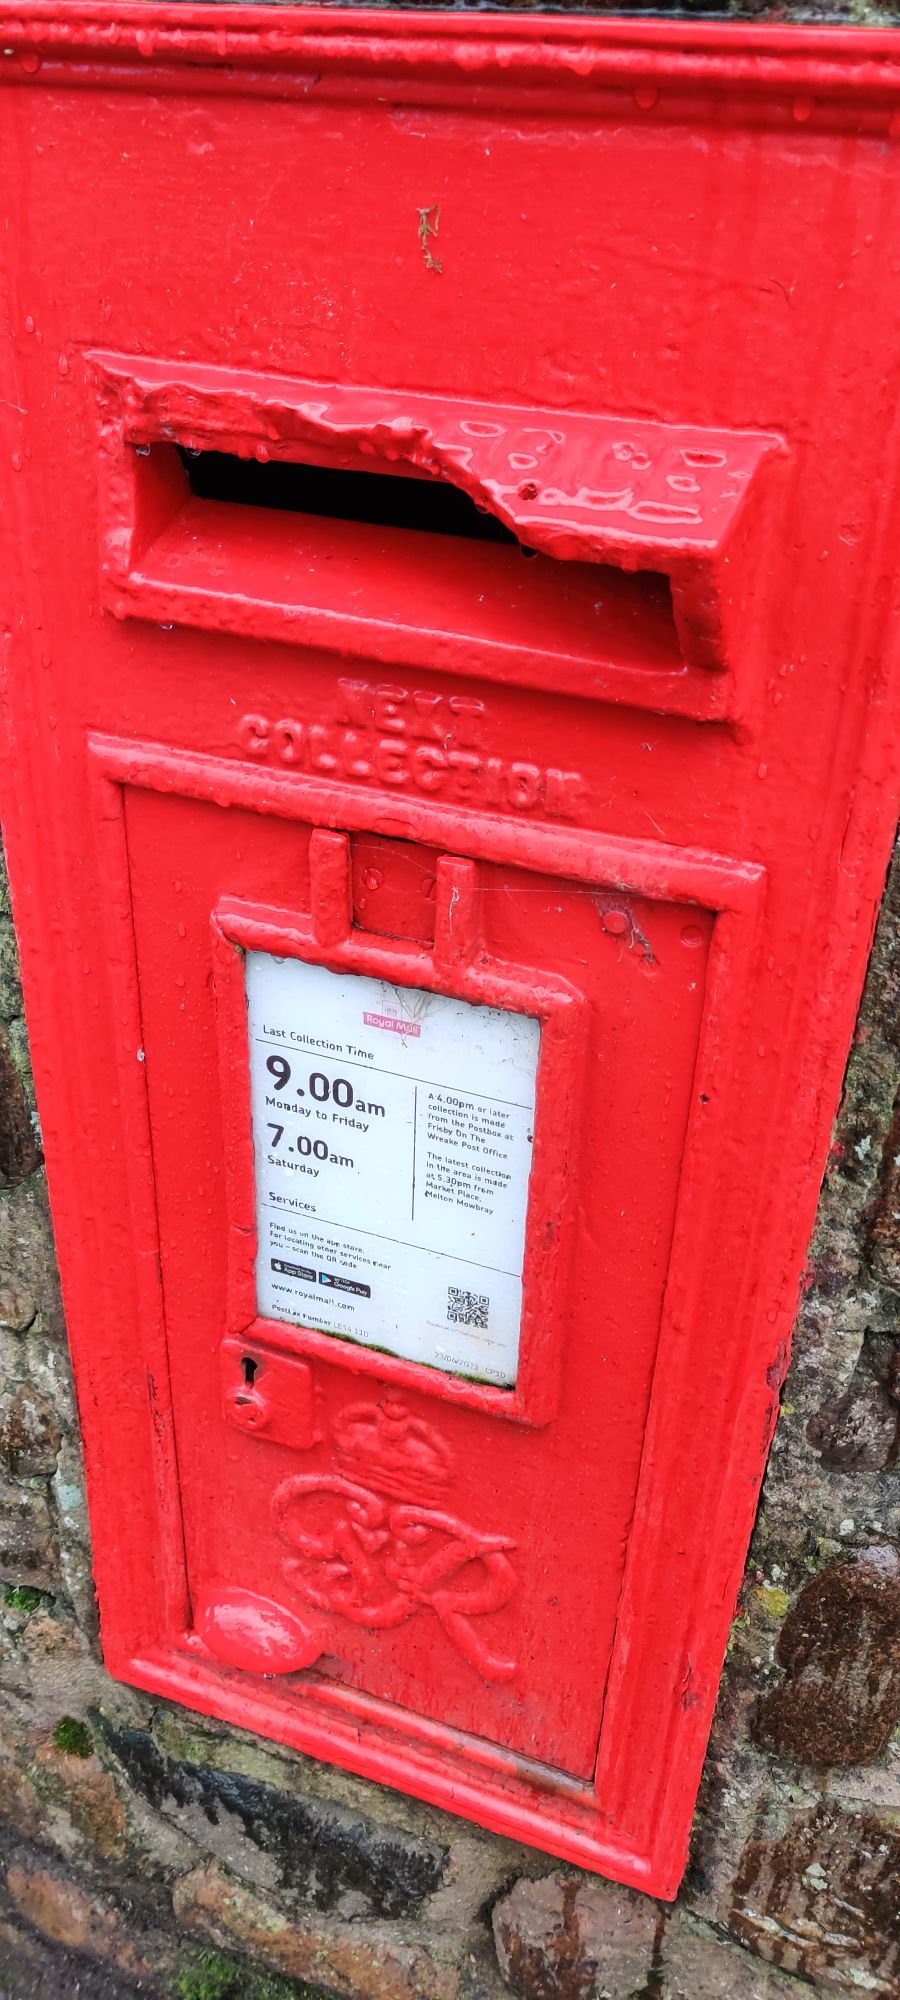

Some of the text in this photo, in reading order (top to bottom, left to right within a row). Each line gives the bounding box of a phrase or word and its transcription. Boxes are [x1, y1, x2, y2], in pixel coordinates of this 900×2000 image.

[238, 712, 585, 818] COLLECTION
[366, 1014, 394, 1029] Royal
[263, 1024, 375, 1060] Last Collection Time
[266, 1055, 386, 1118] 9.00am
[265, 1096, 370, 1133] Monday to Friday
[428, 1092, 510, 1119] A 4.00pm or later
[428, 1103, 506, 1129] collection is made
[427, 1122, 486, 1144] Frisby On The
[428, 1113, 514, 1142] from the Postbox at
[266, 1122, 354, 1168] 7.00am
[427, 1132, 508, 1160] Wreake Post Office
[267, 1155, 320, 1178] Saturday
[427, 1151, 512, 1180] The latest collection
[436, 1163, 451, 1173] the
[453, 1170, 472, 1180] area
[484, 1177, 508, 1190] made
[425, 1180, 455, 1195] Market
[437, 1174, 471, 1190] 5.30pm
[473, 1184, 494, 1196] from
[268, 1191, 317, 1213] Services
[425, 1190, 494, 1216] Melton Mowbray
[269, 1222, 286, 1232] Find
[311, 1233, 324, 1243] the
[269, 1230, 282, 1239] For
[284, 1235, 315, 1250] locating
[316, 1245, 338, 1255] other
[340, 1252, 371, 1265] services
[269, 1240, 284, 1249] you
[292, 1246, 309, 1256] scan
[311, 1251, 324, 1260] the
[326, 1255, 337, 1264] QR
[339, 1260, 358, 1270] code
[283, 1267, 297, 1277] App
[297, 1271, 314, 1281] Store
[333, 1281, 355, 1293] Google
[271, 1283, 355, 1312] www.royalmail.com
